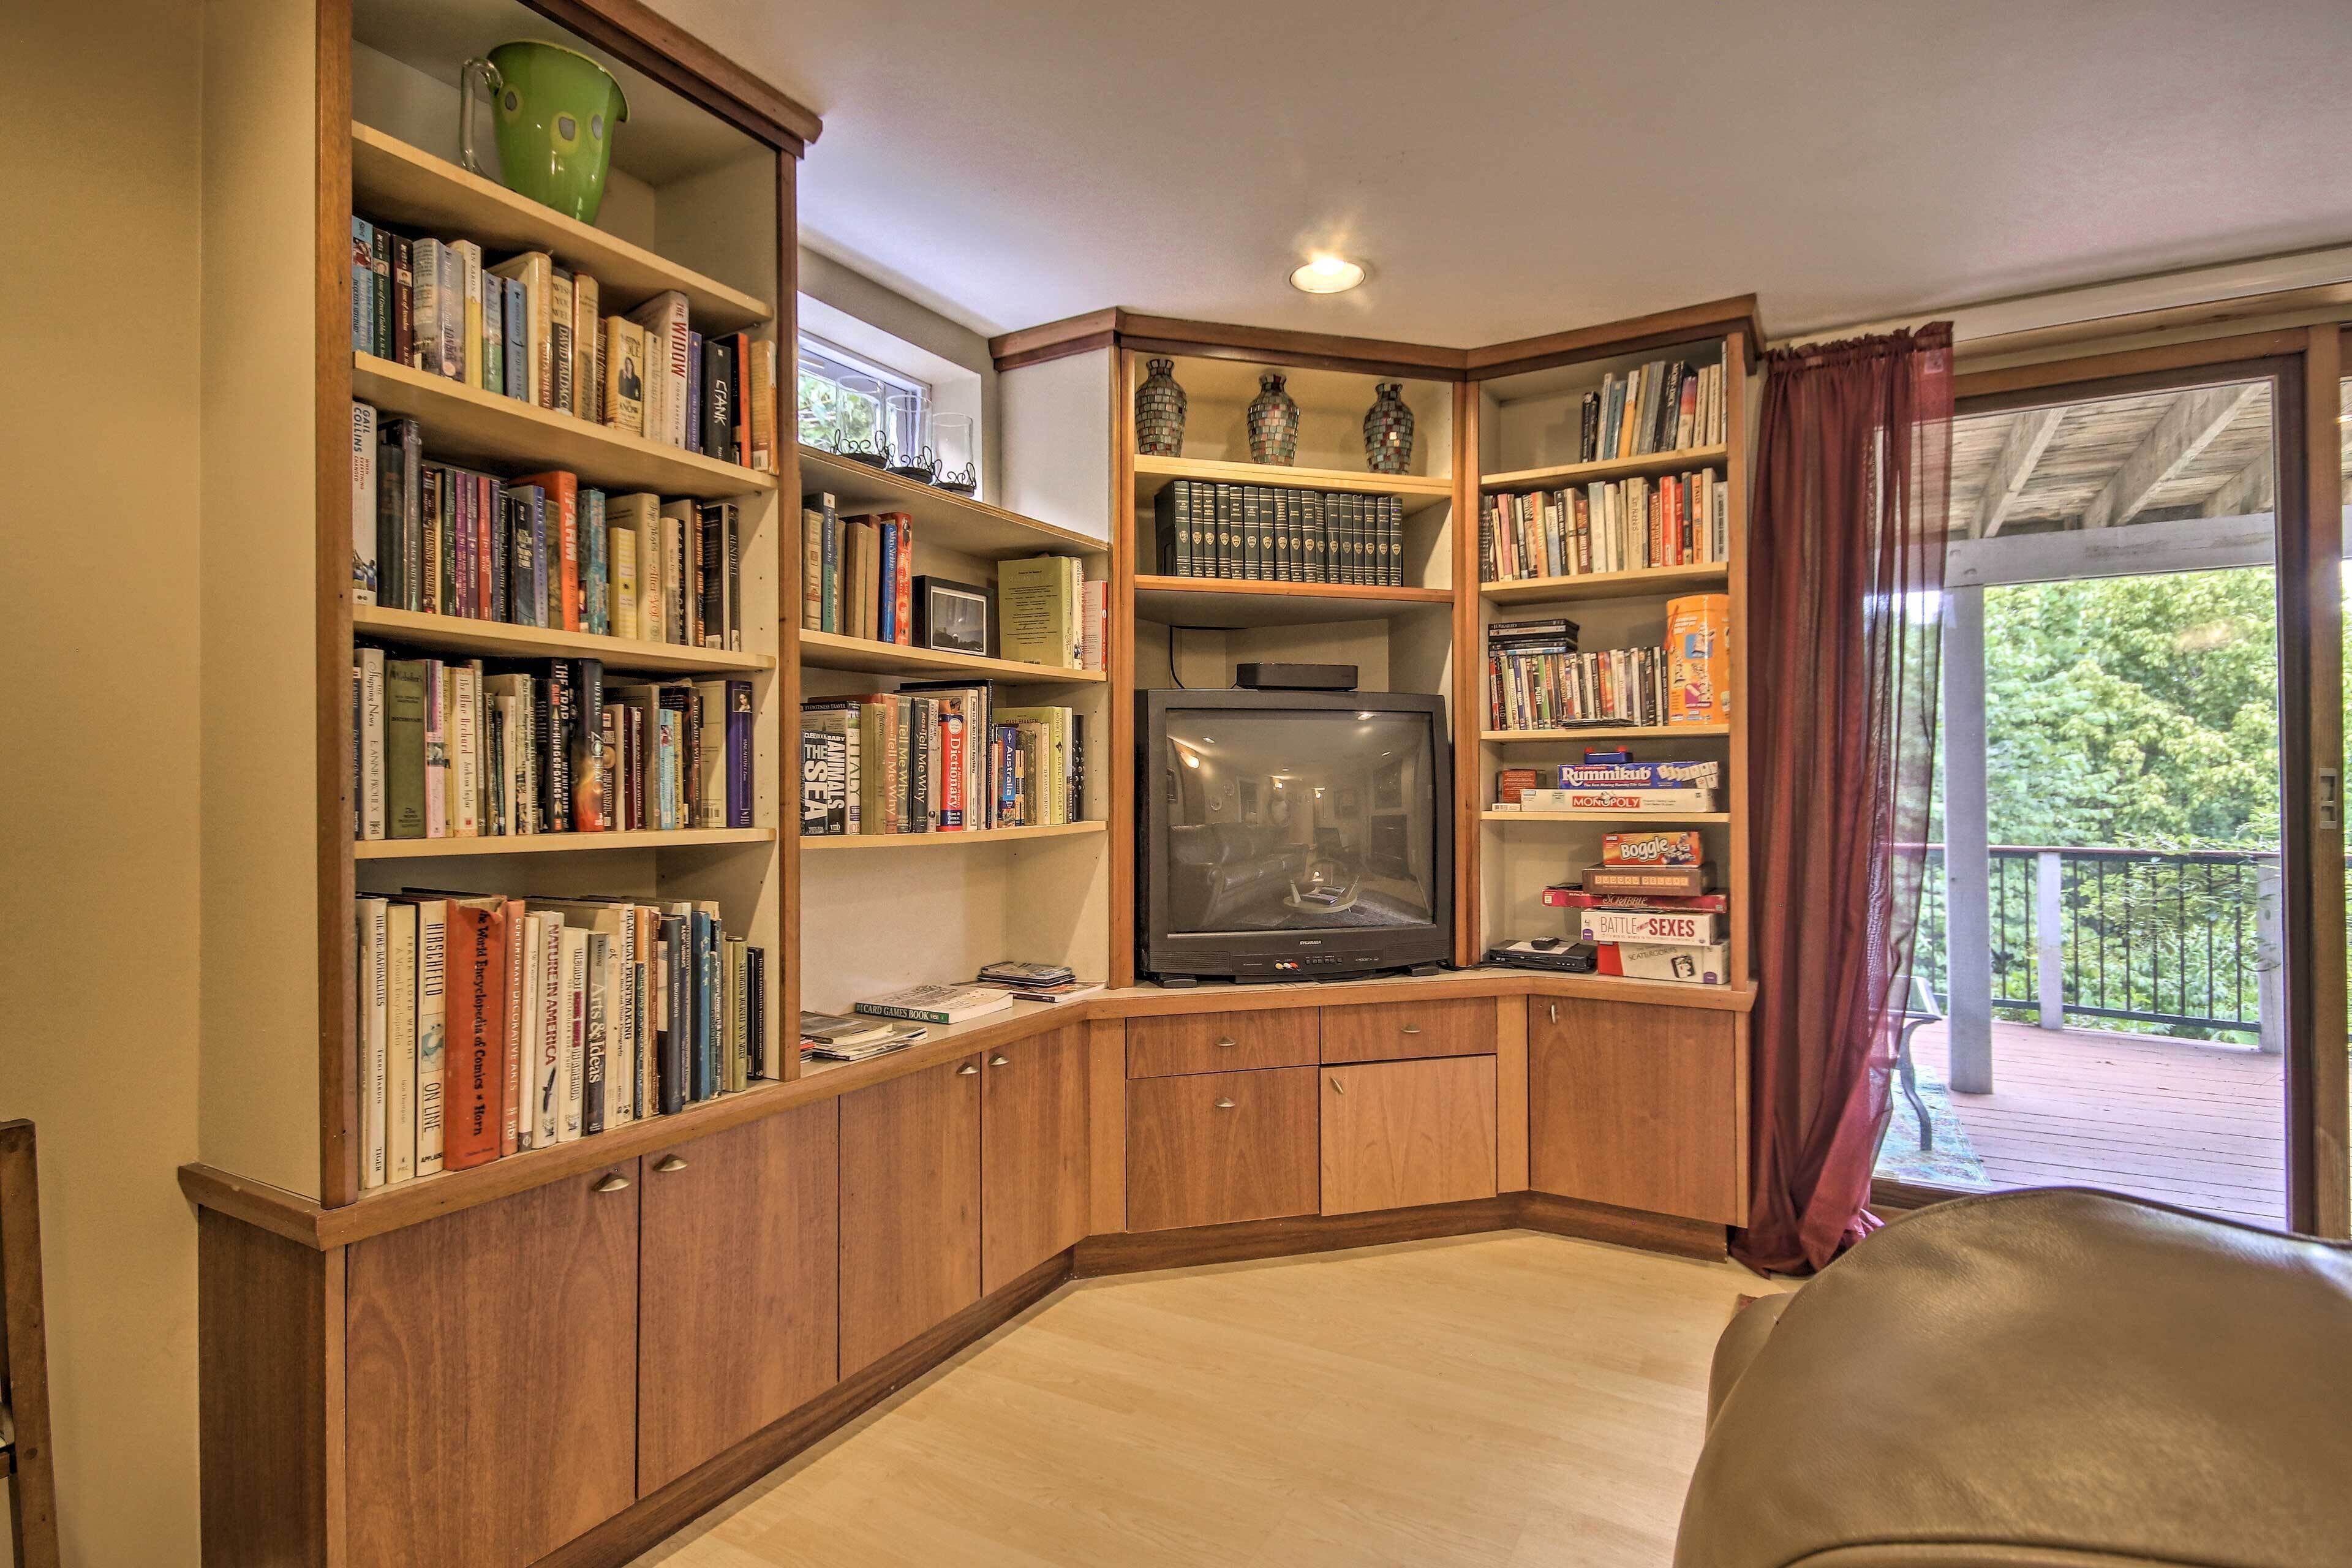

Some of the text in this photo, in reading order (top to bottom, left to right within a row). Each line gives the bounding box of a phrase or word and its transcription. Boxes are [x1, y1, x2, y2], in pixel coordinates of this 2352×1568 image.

[559, 326, 569, 360] DAVID
[671, 322, 686, 378] WIDOW
[565, 500, 576, 562] FARM
[426, 530, 435, 595] CHASING VERMEER
[368, 662, 382, 726] Shipping News
[460, 695, 472, 714] Blue
[560, 690, 569, 720] TRAP
[461, 718, 473, 754] Orchard
[876, 710, 885, 737] Rhetoric
[804, 745, 827, 759] THE
[919, 731, 927, 750] Tell
[371, 750, 379, 777] ANNIE
[827, 742, 845, 810] ANIMALS
[848, 742, 860, 799] ITALY
[889, 761, 896, 781] Me
[897, 723, 908, 800] Tell Me Why
[918, 753, 927, 772] Me
[949, 737, 961, 808] Dictionary
[1562, 766, 1652, 786] Rummikub
[464, 790, 473, 808] Taylor
[804, 760, 827, 821] SEA
[886, 785, 897, 815] Why
[914, 775, 925, 803] Why
[1573, 797, 1639, 807] MONOPOLY
[1620, 835, 1669, 861] Boggle
[1642, 876, 1689, 884] DELUXE
[1603, 894, 1648, 906] SCRABBLE
[1600, 916, 1637, 934] BATTLE
[1649, 918, 1695, 937] SEXES
[475, 927, 488, 957] World
[575, 949, 583, 965] THE
[376, 932, 385, 1006] PRE-RAPHAELITES
[426, 924, 444, 997] HIRSCHFELD
[574, 966, 582, 989] MOST
[473, 960, 488, 1034] Encyclopedia
[545, 924, 559, 1066] NATURE IN AMERICA
[393, 987, 402, 1046] Encyclopedia
[511, 990, 520, 1060] DECORATIVE
[864, 1005, 929, 1020] CARD GAMES BOOK
[473, 1037, 487, 1046] of
[572, 1020, 581, 1047] DRIVES
[588, 982, 605, 1083] Arts & Ideas
[473, 1049, 486, 1089] Comics
[571, 1049, 581, 1060] IN
[571, 1060, 580, 1100] AMERICA
[423, 1083, 440, 1133] ON LINE
[473, 1105, 484, 1136] Horn
